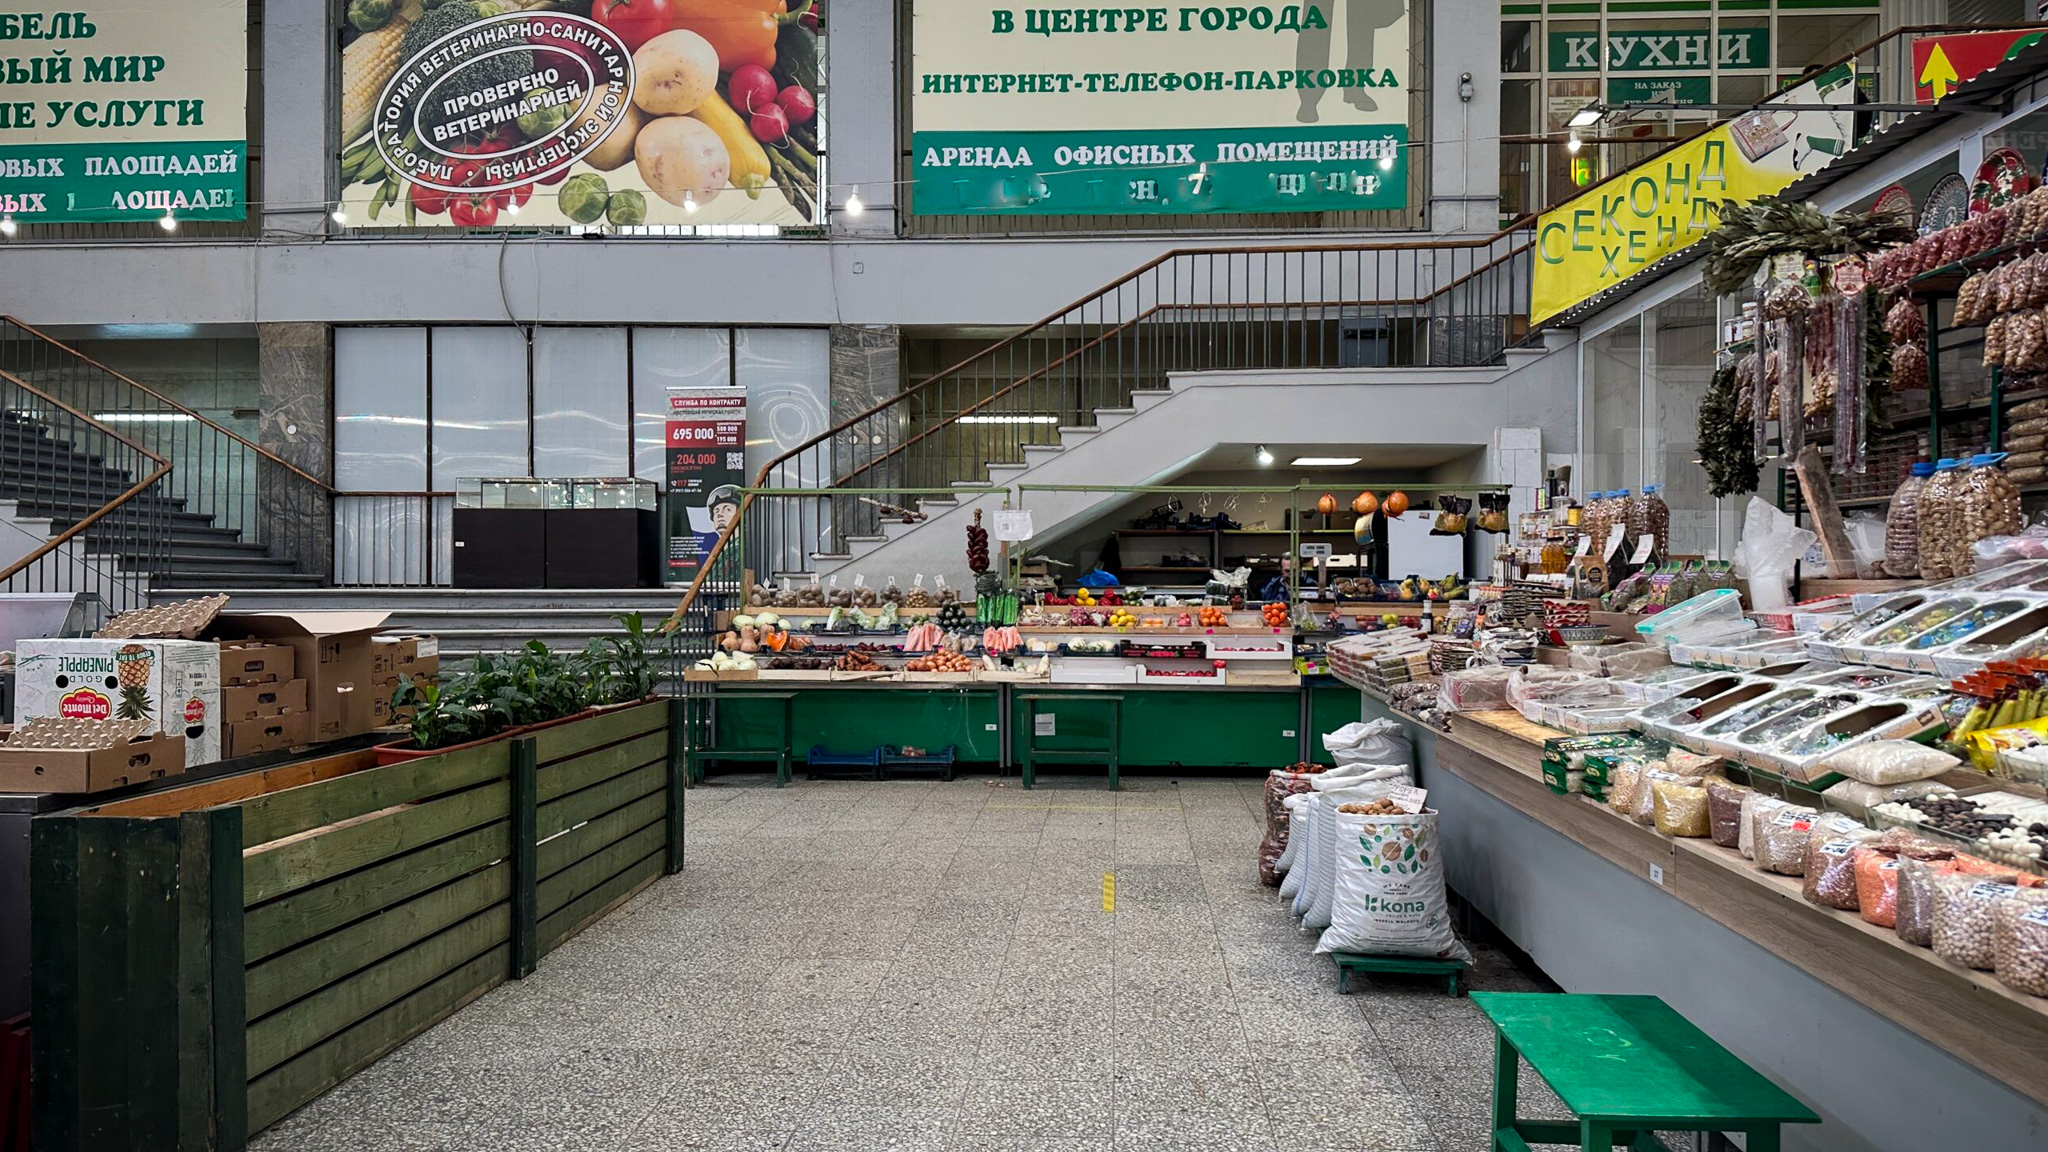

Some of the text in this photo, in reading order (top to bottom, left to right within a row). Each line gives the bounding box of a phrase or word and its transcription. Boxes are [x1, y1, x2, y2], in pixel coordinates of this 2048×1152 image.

[991, 5, 1329, 37] В ЦЕНТРЕ ГОРОДА
[1565, 33, 1751, 68] КУХНИ
[83, 55, 165, 83] МИР
[921, 67, 1400, 94] ИНТЕРНЕТ-ТЕЛЕФОН-ПАРКОВКА
[443, 67, 559, 117] ПРОВЕРЕНО
[1634, 81, 1682, 90] НА ЗАКАЗ
[46, 99, 204, 128] УСЛУГИ
[384, 21, 625, 181] ЛАБОРАТОРИЯ ВЕТЕРИНАРНО-САНИТАРНОЙ ЭКСПЕРТИЗЫ
[432, 80, 582, 142] ВЕТЕРИНАРИЕЙ
[84, 149, 238, 177] ПЛОЩАДЕЙ
[921, 134, 1398, 169] АРЕНДА ОФИСНЫХ ПОМЕЩЕНИЙ
[1539, 140, 1727, 265] СЕКОНД
[1599, 197, 1709, 278] ХЕНД
[672, 428, 714, 440] 695 000
[676, 453, 717, 465] 204 000
[58, 656, 114, 673] PINEAPPLE
[69, 675, 103, 683] GOLD
[63, 703, 107, 714] Del Monte
